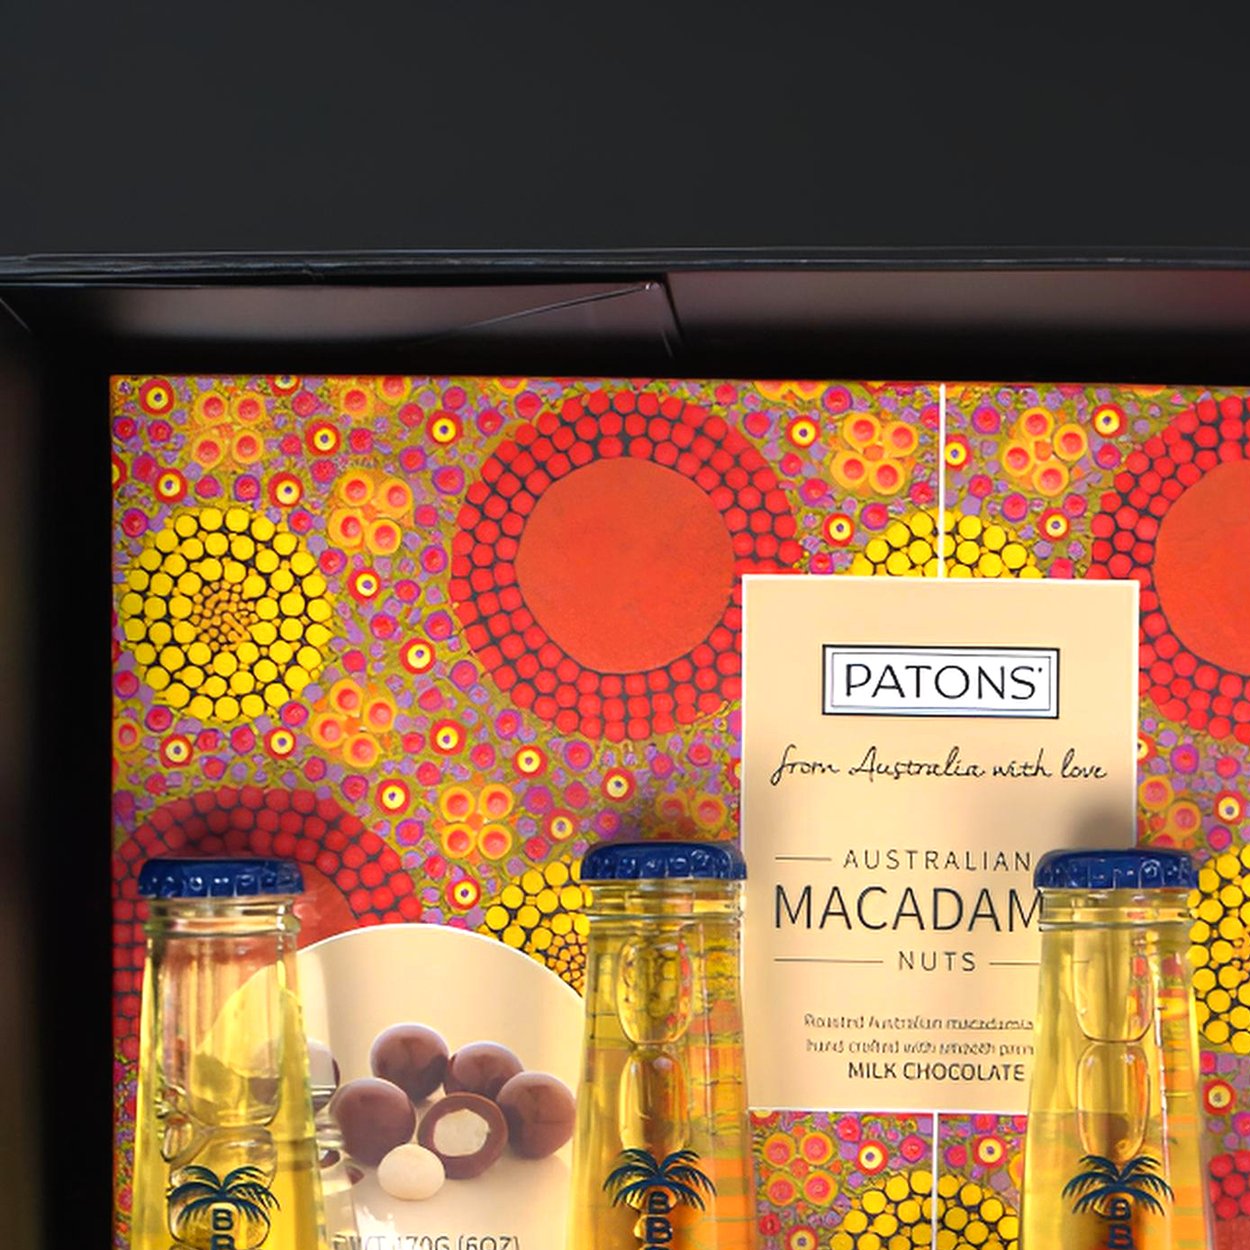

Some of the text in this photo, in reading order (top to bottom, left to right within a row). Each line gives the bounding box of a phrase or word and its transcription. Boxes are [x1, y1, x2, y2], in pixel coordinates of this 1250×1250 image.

[770, 744, 1108, 785] from Australia with love
[844, 849, 1031, 872] AUSTRALIAN
[774, 884, 1044, 933] MACADAM
[898, 950, 977, 972] NUTS
[848, 1061, 1025, 1082] MILK CHOCOLATE
